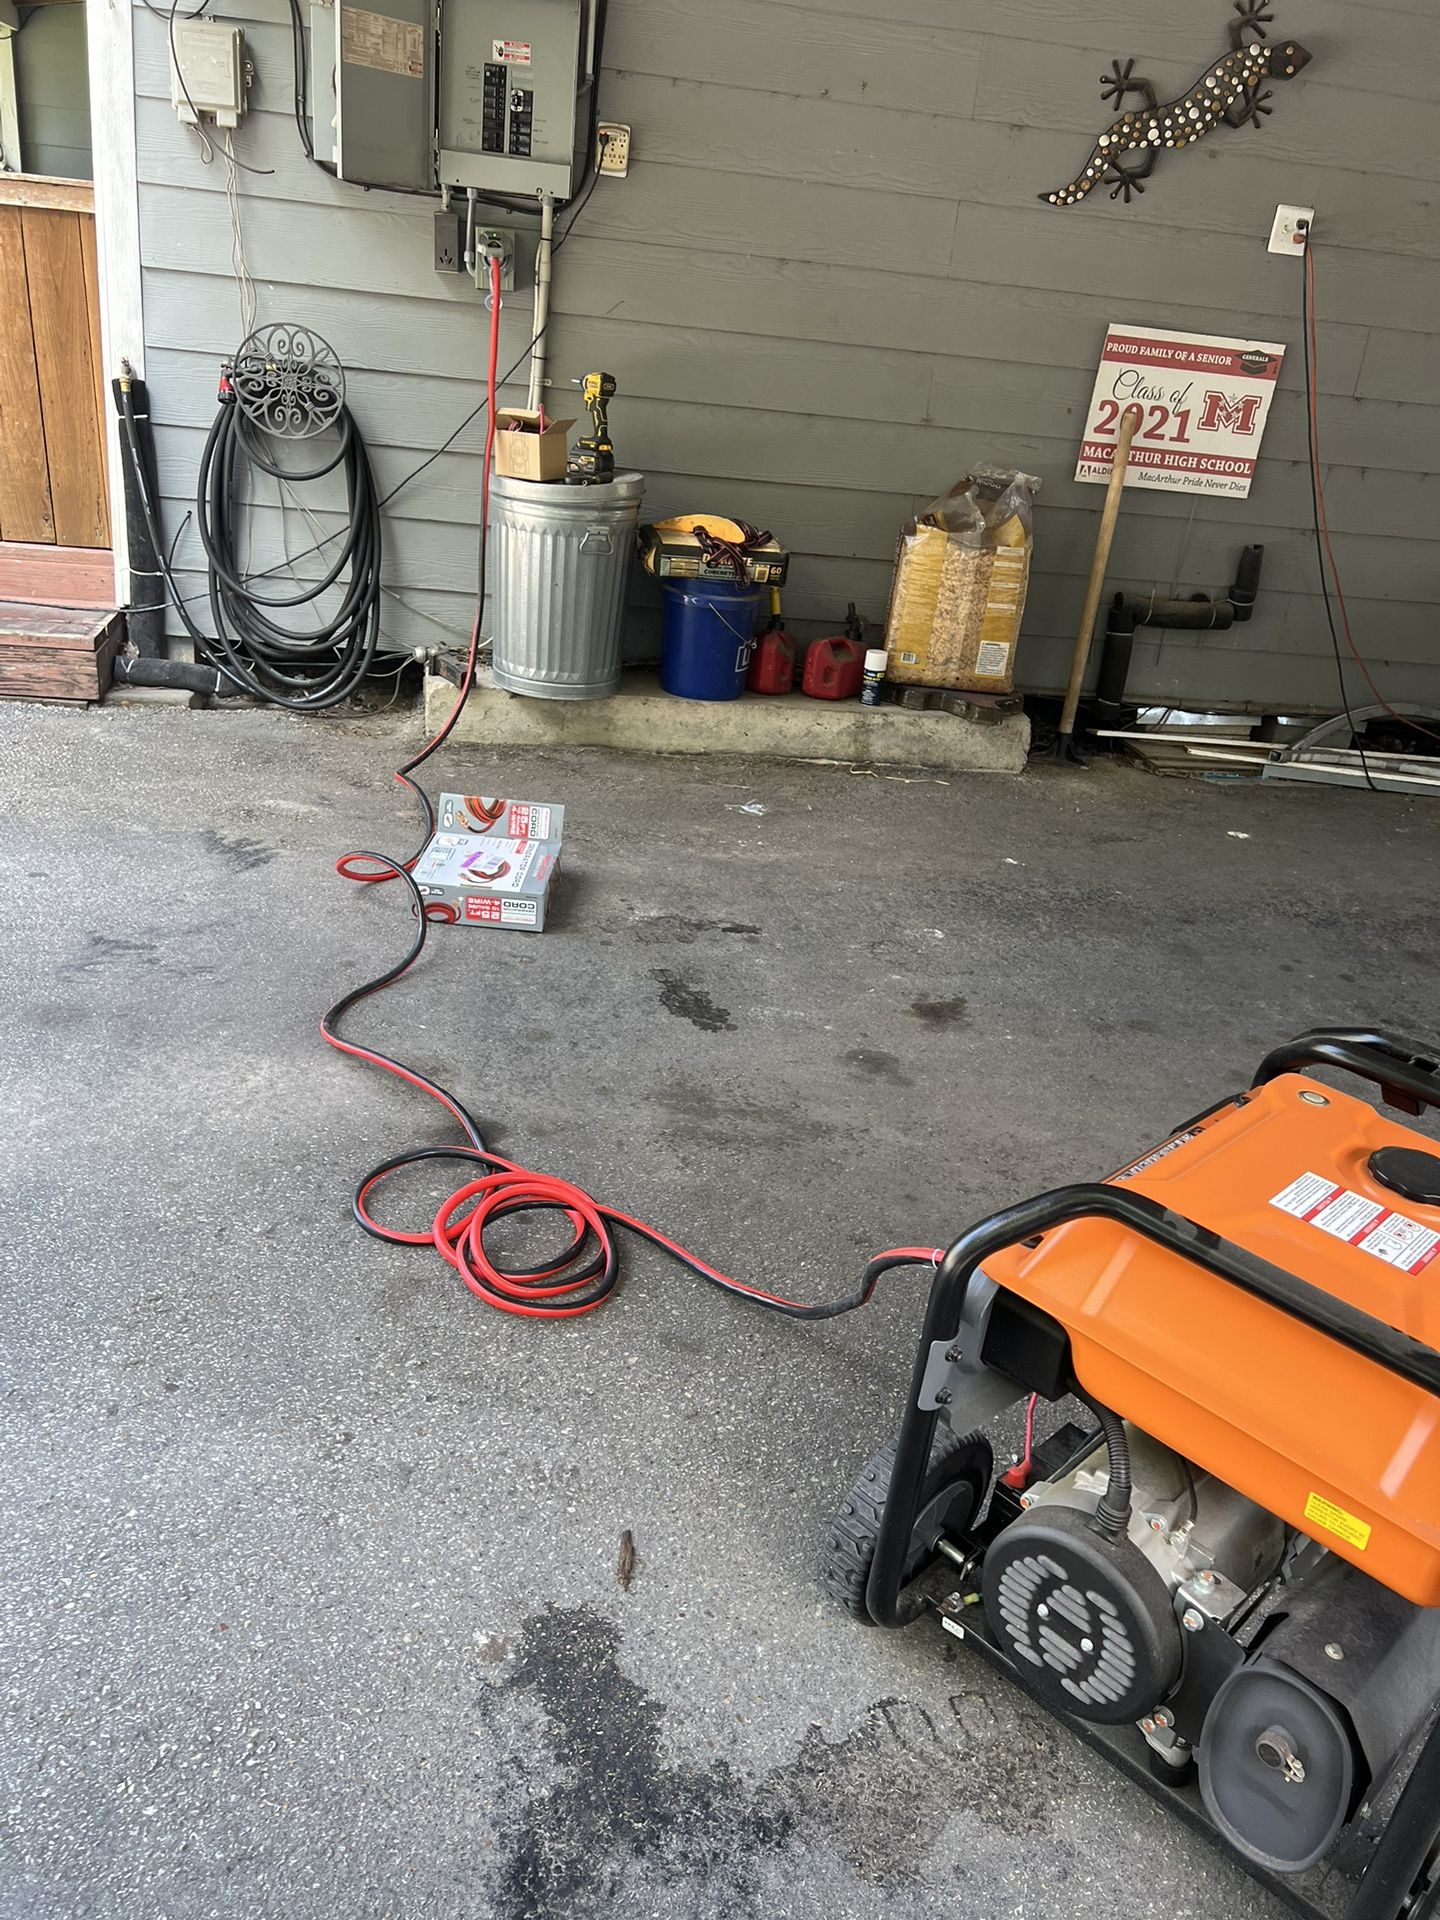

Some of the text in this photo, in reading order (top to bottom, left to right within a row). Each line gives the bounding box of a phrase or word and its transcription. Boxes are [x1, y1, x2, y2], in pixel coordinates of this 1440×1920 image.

[1106, 342, 1232, 365] PROUD FAMILY OF A SENIOR
[1112, 368, 1193, 415] Class of
[1093, 399, 1192, 443] 2021
[1197, 390, 1263, 436] M
[1164, 454, 1198, 468] HIGH
[1199, 458, 1251, 474] SCHOOL
[1137, 472, 1247, 492] MacArthur Pride Never Dies
[770, 566, 782, 575] 60
[503, 901, 535, 910] CORD
